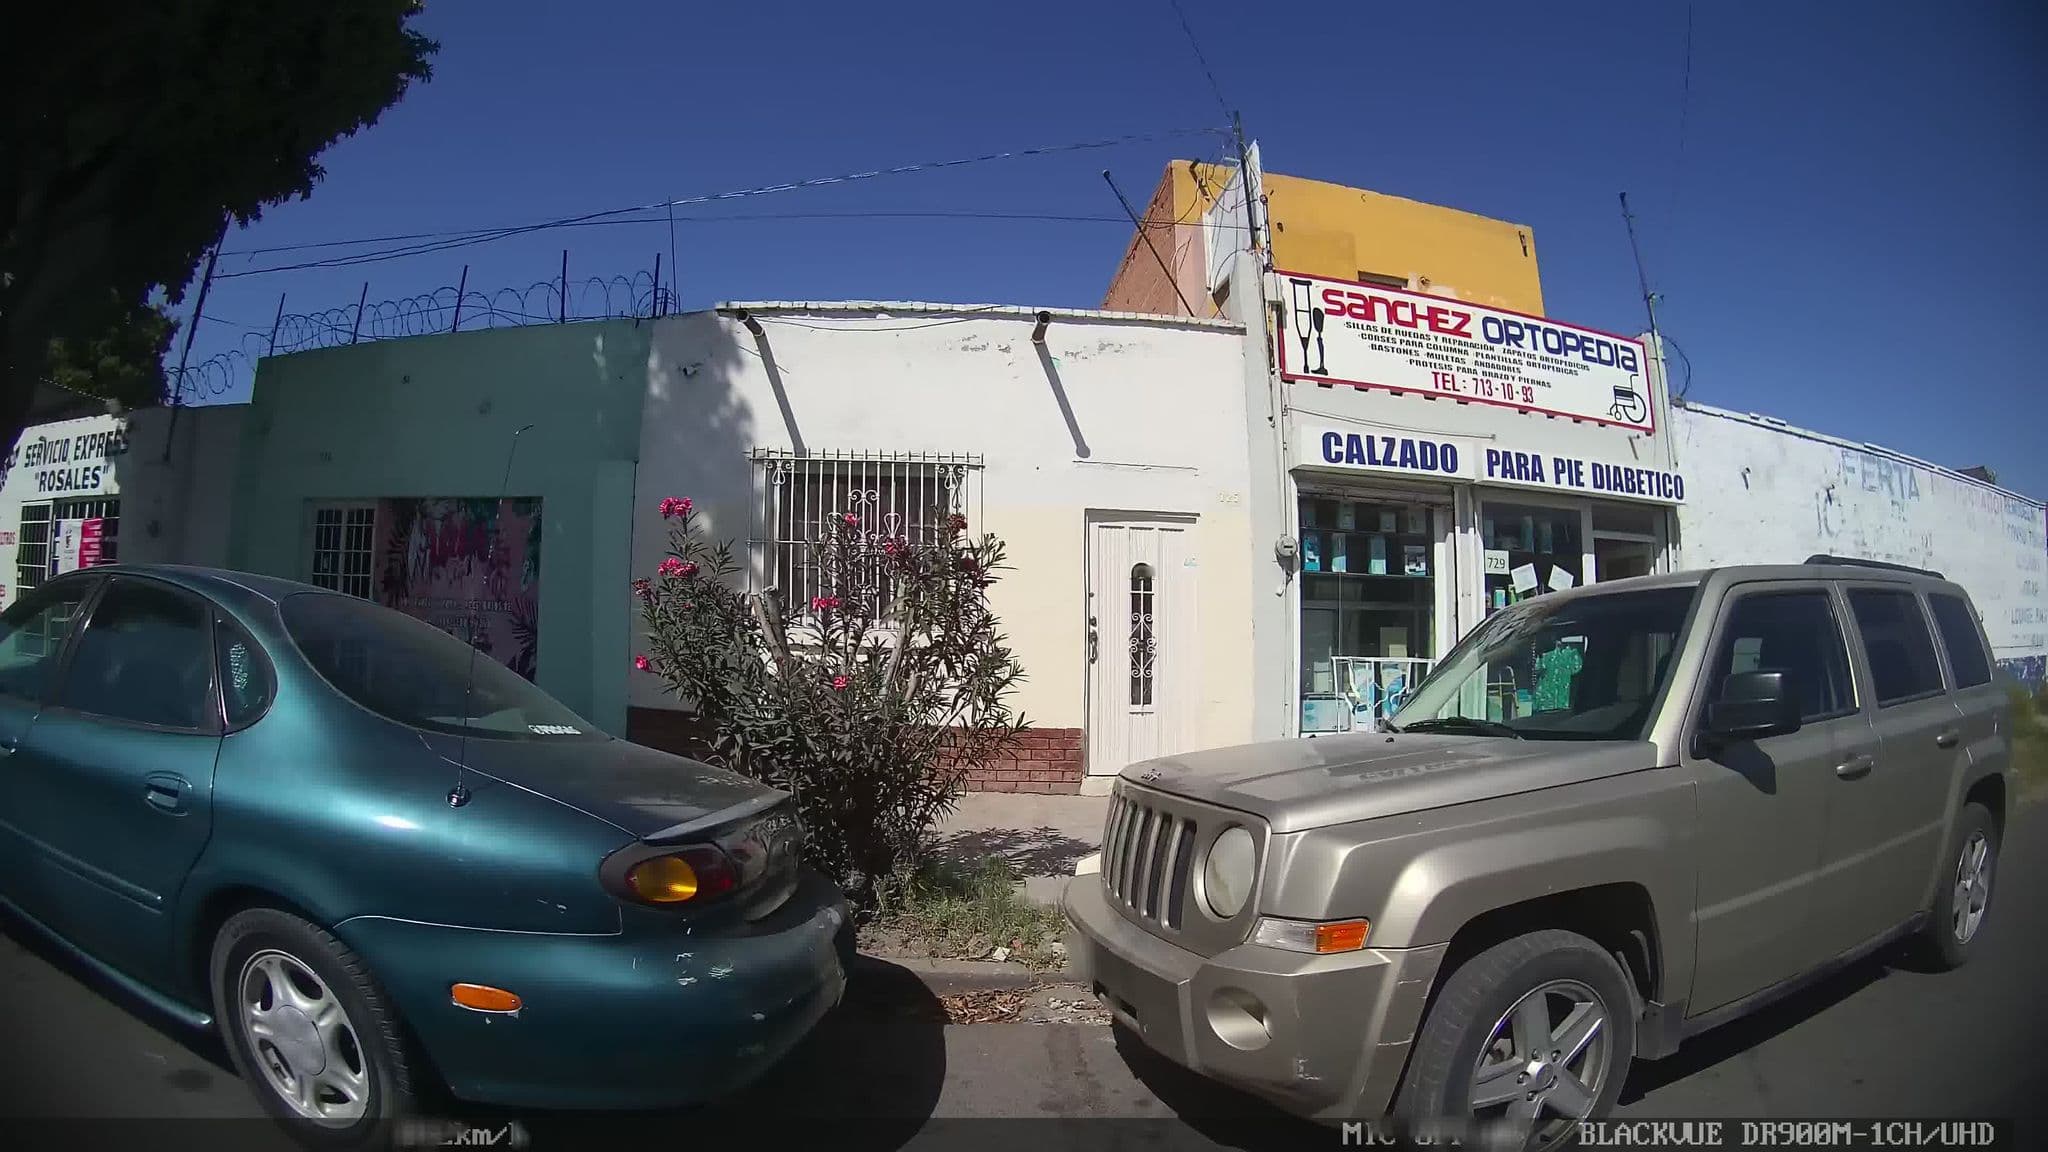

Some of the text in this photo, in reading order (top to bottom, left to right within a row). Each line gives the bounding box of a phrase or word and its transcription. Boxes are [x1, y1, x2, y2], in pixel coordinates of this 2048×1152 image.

[1344, 321, 1378, 333] SILLAS
[1395, 329, 1431, 341] RUEDAS
[1502, 348, 1537, 360] ZAPATOS
[1400, 339, 1423, 348] PARA
[1426, 342, 1469, 356] COLUMNA
[1426, 351, 1466, 365] MULETAS
[1456, 366, 1478, 375] PARA
[1431, 371, 1467, 392] TEL:
[24, 437, 70, 468] SERVICIO
[1322, 430, 1458, 474] CALZADO
[1486, 448, 1685, 501] PARA PIE DIABETICO
[1487, 556, 1506, 569] 729
